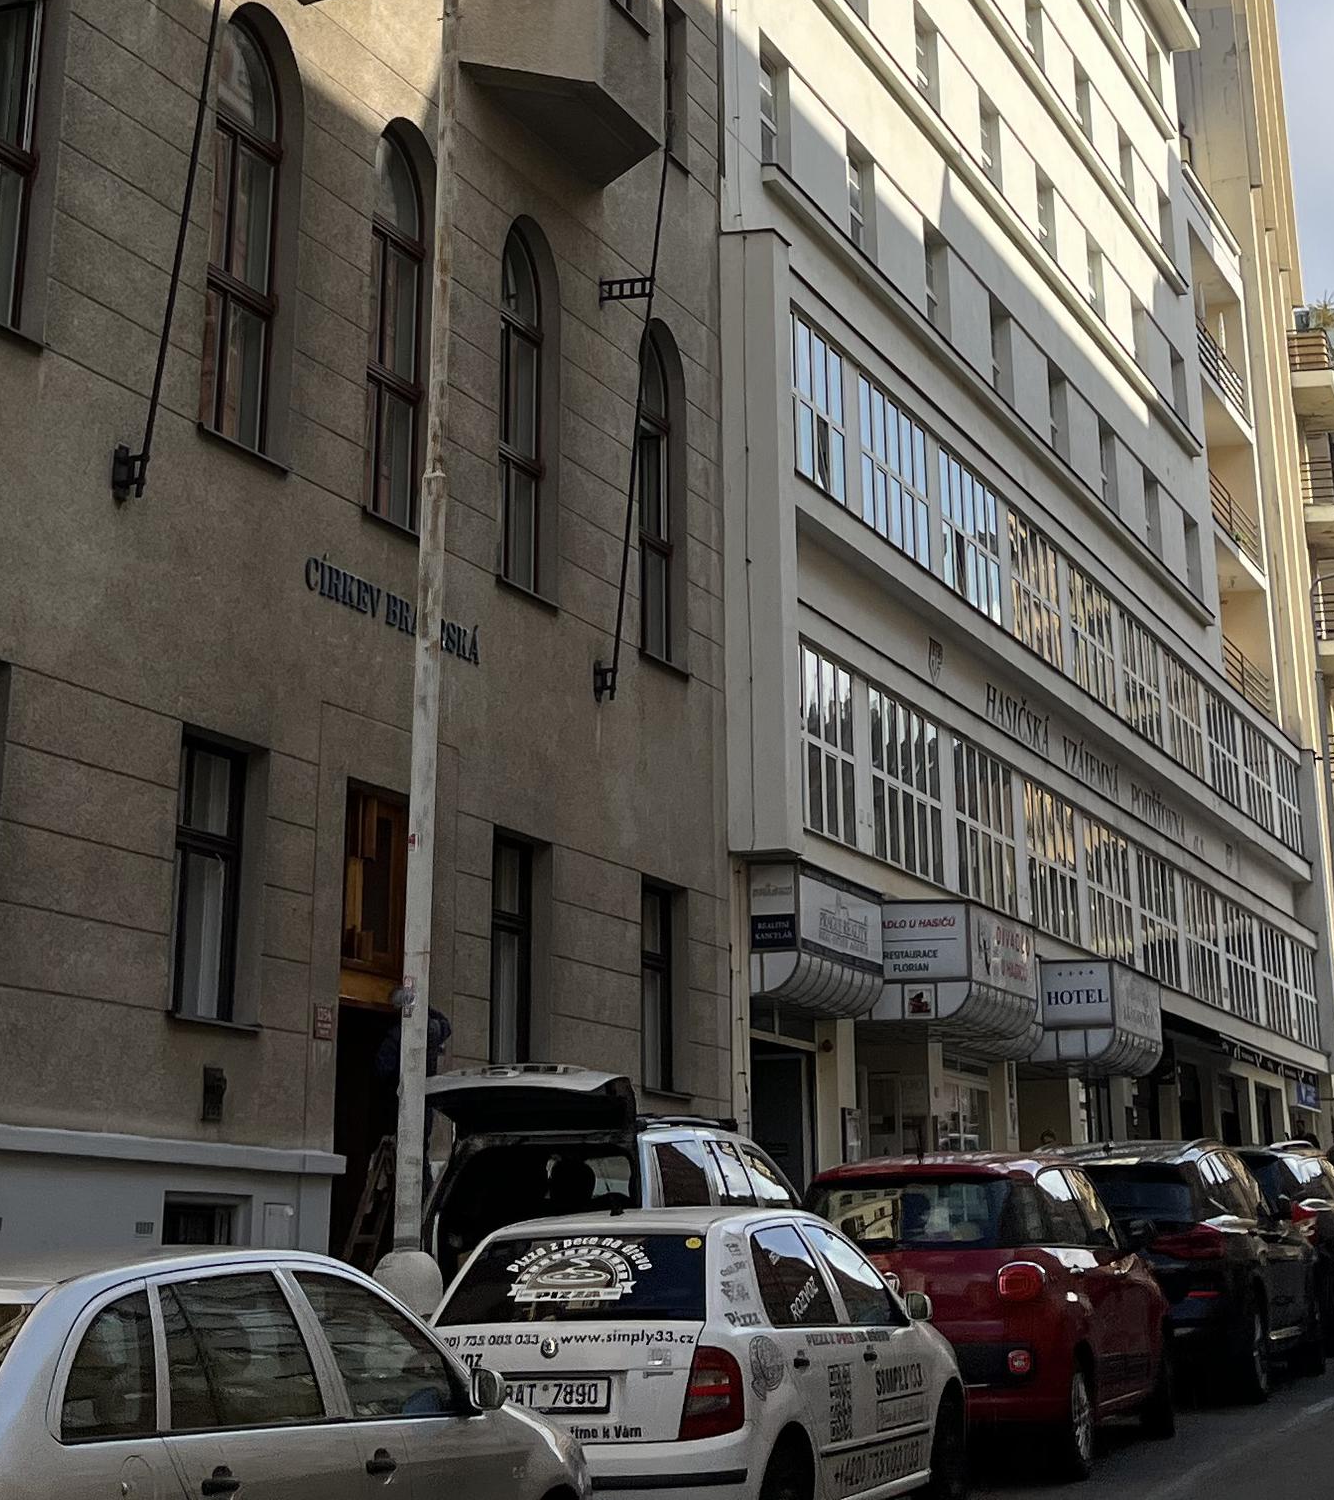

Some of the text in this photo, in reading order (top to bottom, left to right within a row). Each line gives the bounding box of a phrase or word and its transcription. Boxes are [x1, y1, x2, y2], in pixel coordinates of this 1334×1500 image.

[305, 552, 480, 666] CÍRKEV BRASKÁ
[986, 682, 1050, 757] HASIČSKÁ
[882, 919, 906, 930] ADLO
[909, 919, 916, 928] U
[882, 949, 939, 960] RESTAURACE
[893, 962, 930, 973] FLORIAN
[1047, 989, 1109, 1006] HOTEL
[506, 1247, 547, 1273] Pizza
[550, 1242, 559, 1251] z
[601, 1237, 624, 1250] na
[560, 1329, 695, 1346] www.simply33.cz
[552, 1383, 598, 1406] 7890
[613, 1424, 642, 1438] Vám
